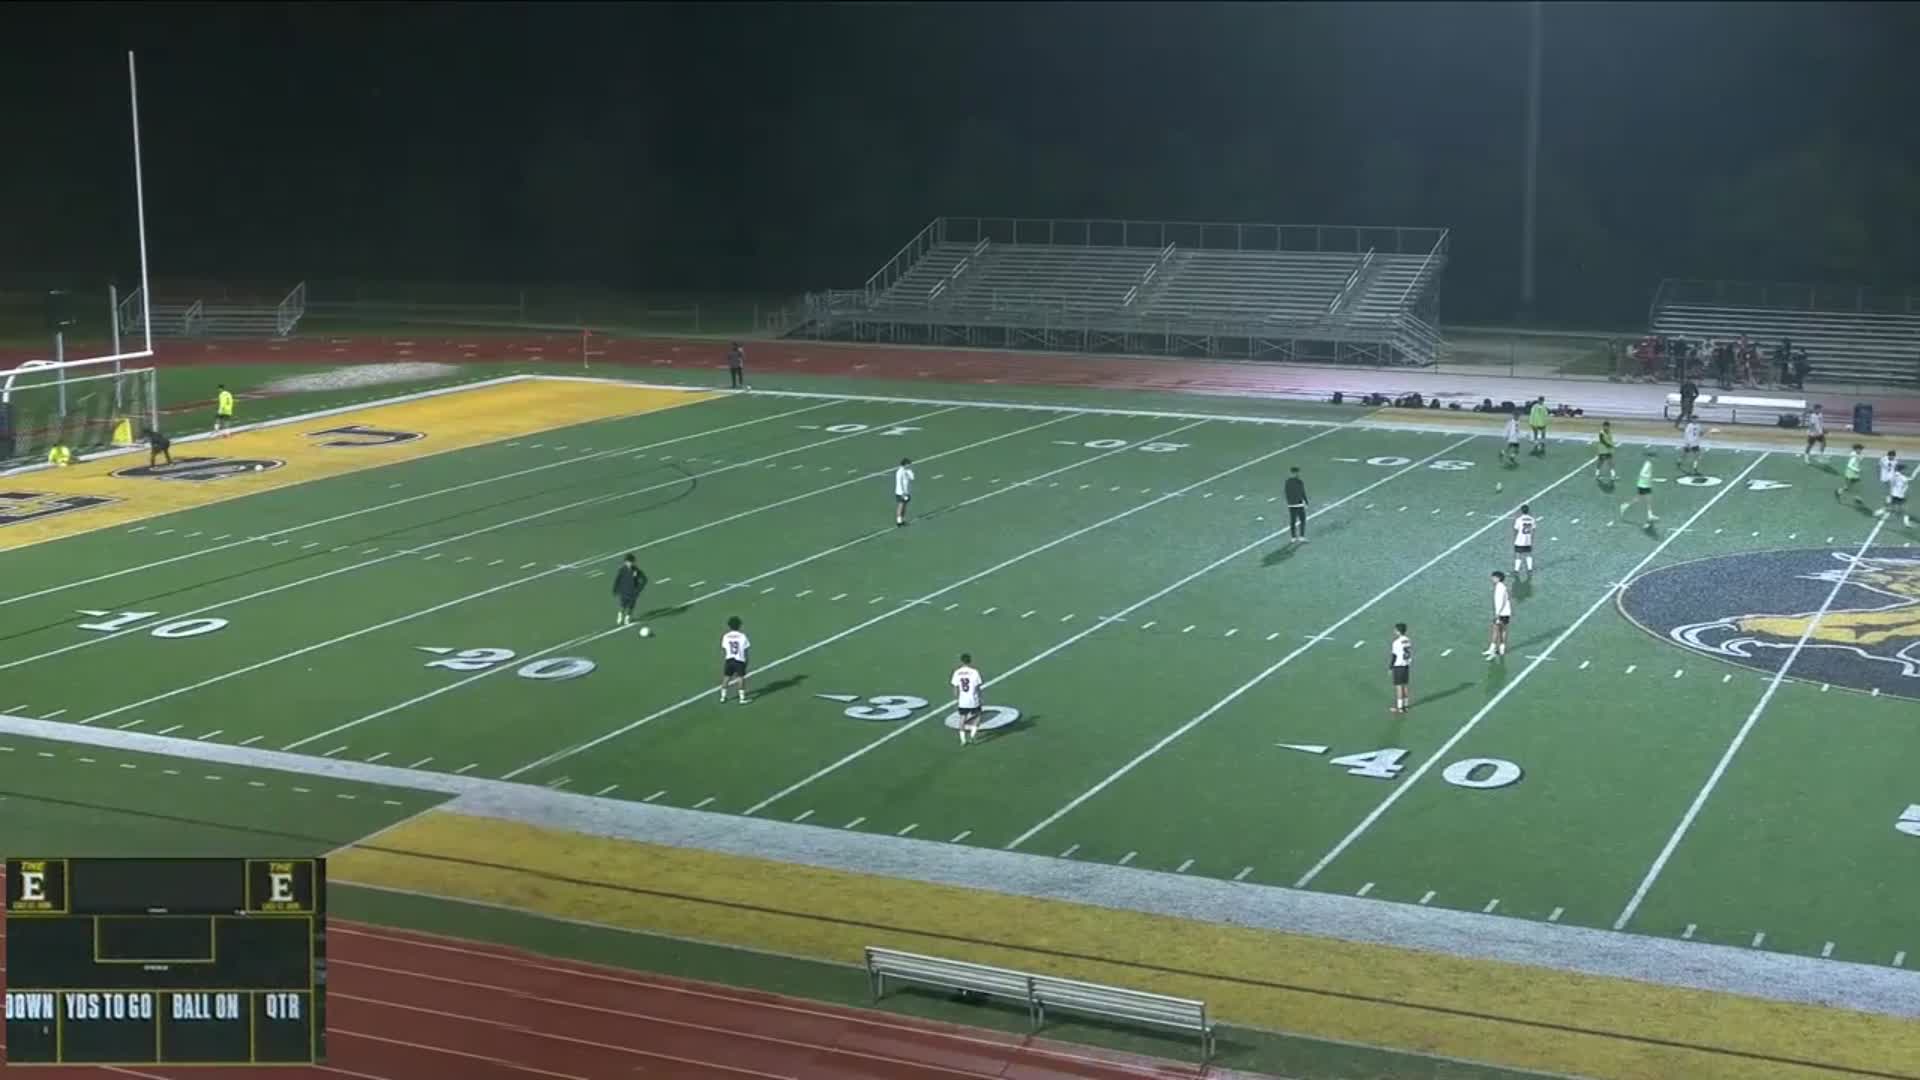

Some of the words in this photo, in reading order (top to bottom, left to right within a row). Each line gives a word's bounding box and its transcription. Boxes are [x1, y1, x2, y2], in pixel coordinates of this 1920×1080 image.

[78, 611, 228, 638] 10
[424, 647, 597, 680] 20
[844, 695, 1022, 730] 30
[1330, 746, 1523, 789] 40
